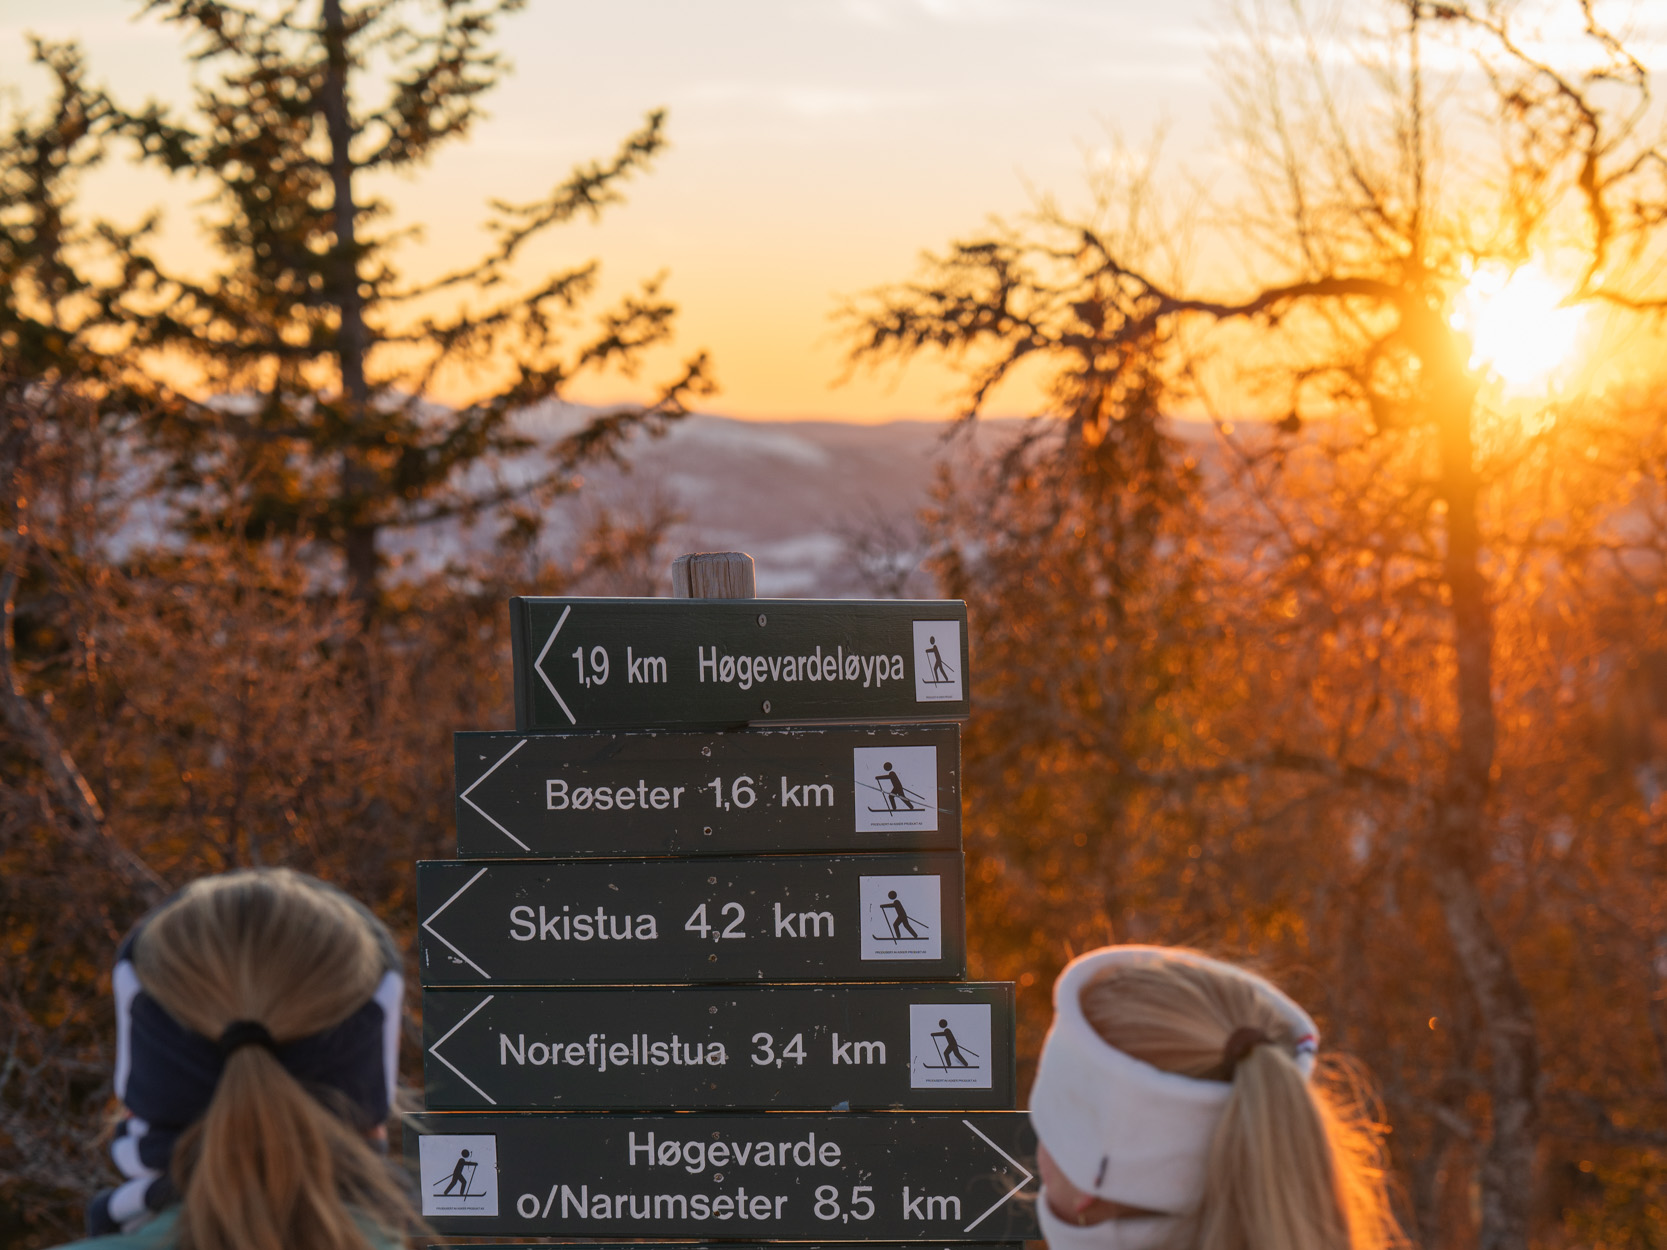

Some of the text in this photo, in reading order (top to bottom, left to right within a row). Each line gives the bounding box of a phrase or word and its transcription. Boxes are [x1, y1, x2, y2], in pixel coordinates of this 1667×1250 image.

[571, 645, 905, 690] 1,9 km Høgevardeløypa
[546, 775, 834, 812] Bøseter 1,6 km
[509, 905, 659, 942] Skistua
[772, 902, 835, 938] km
[499, 1032, 886, 1073] Norefjellstua 3,4 km
[628, 1131, 842, 1174] Høgevarde
[516, 1184, 961, 1224] o/Narumseter 8,5 km
